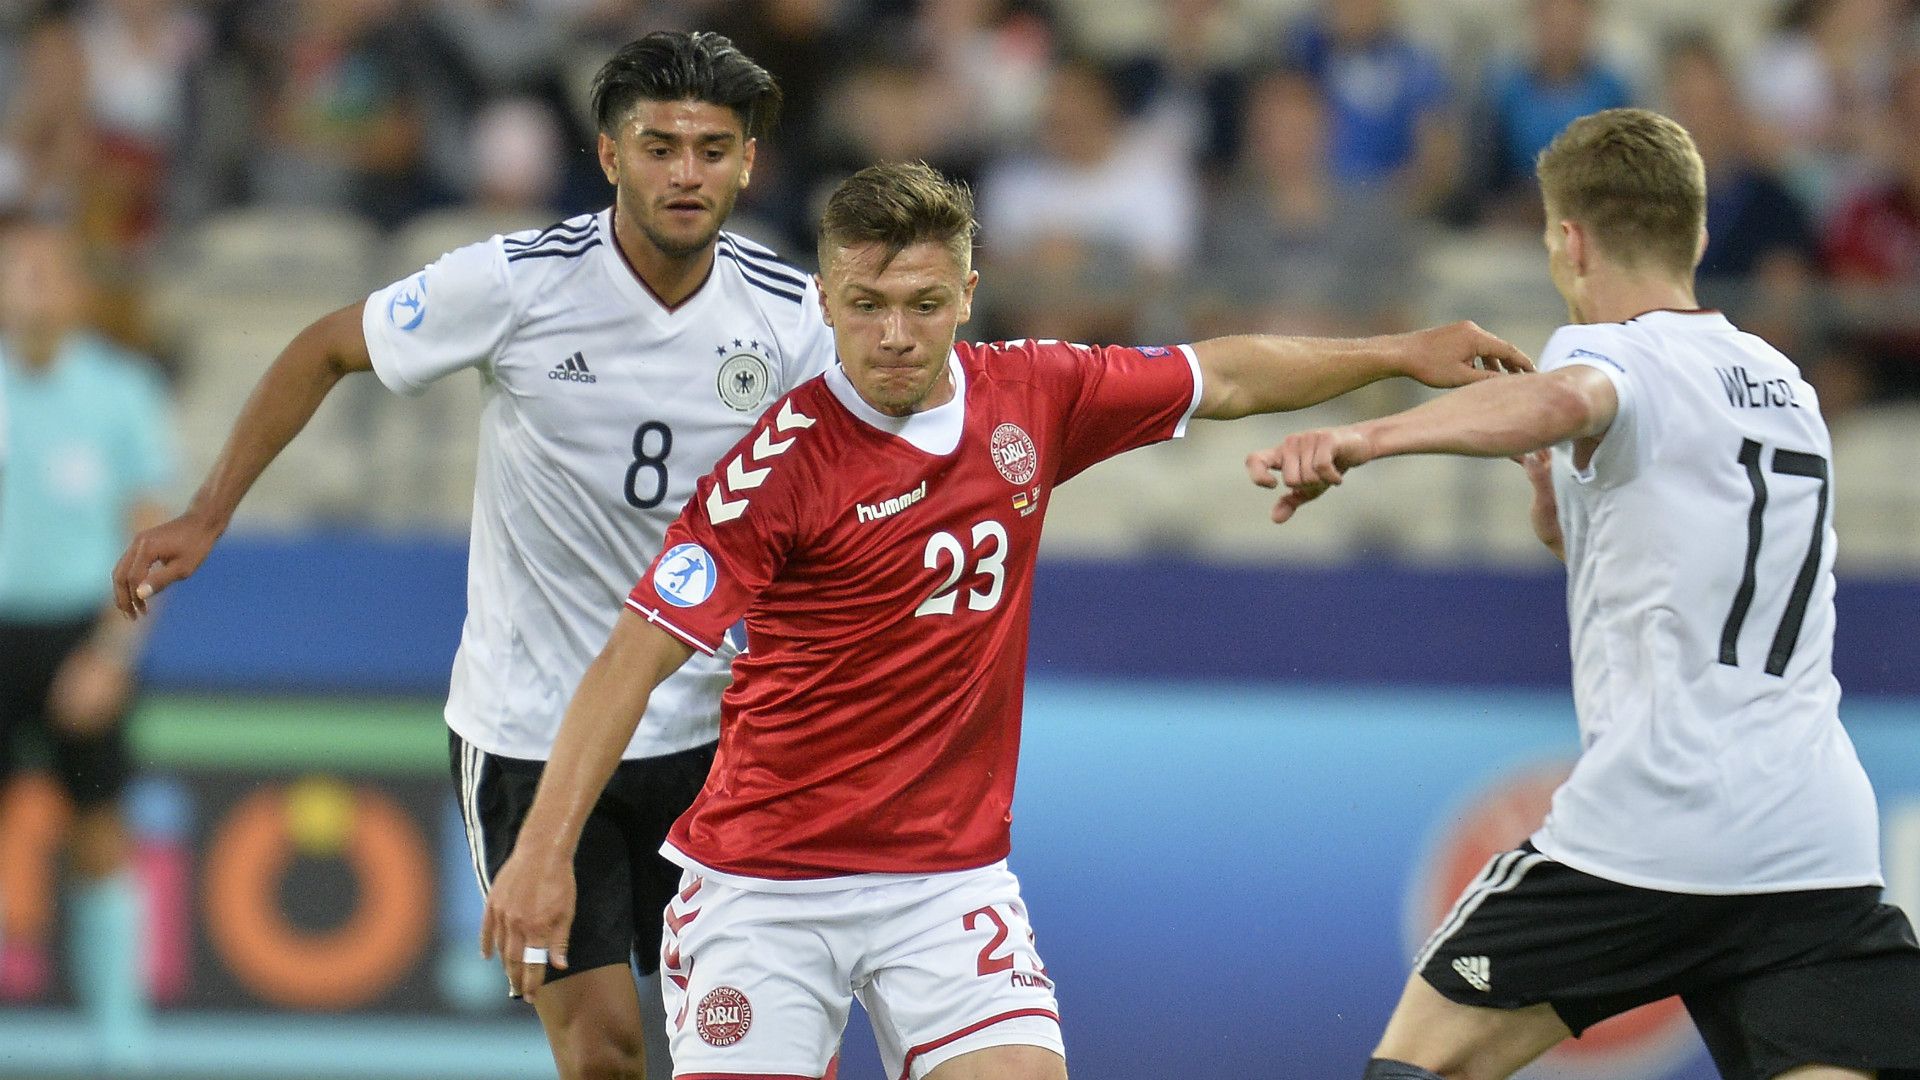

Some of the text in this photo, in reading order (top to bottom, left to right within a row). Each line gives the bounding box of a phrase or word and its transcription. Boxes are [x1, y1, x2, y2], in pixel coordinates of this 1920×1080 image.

[548, 368, 597, 384] adidas
[624, 420, 673, 509] 8
[1000, 440, 1028, 465] DBU
[856, 480, 926, 523] hummel
[914, 520, 1008, 617] 23
[1718, 436, 1828, 677] 17
[706, 1006, 740, 1026] DBU
